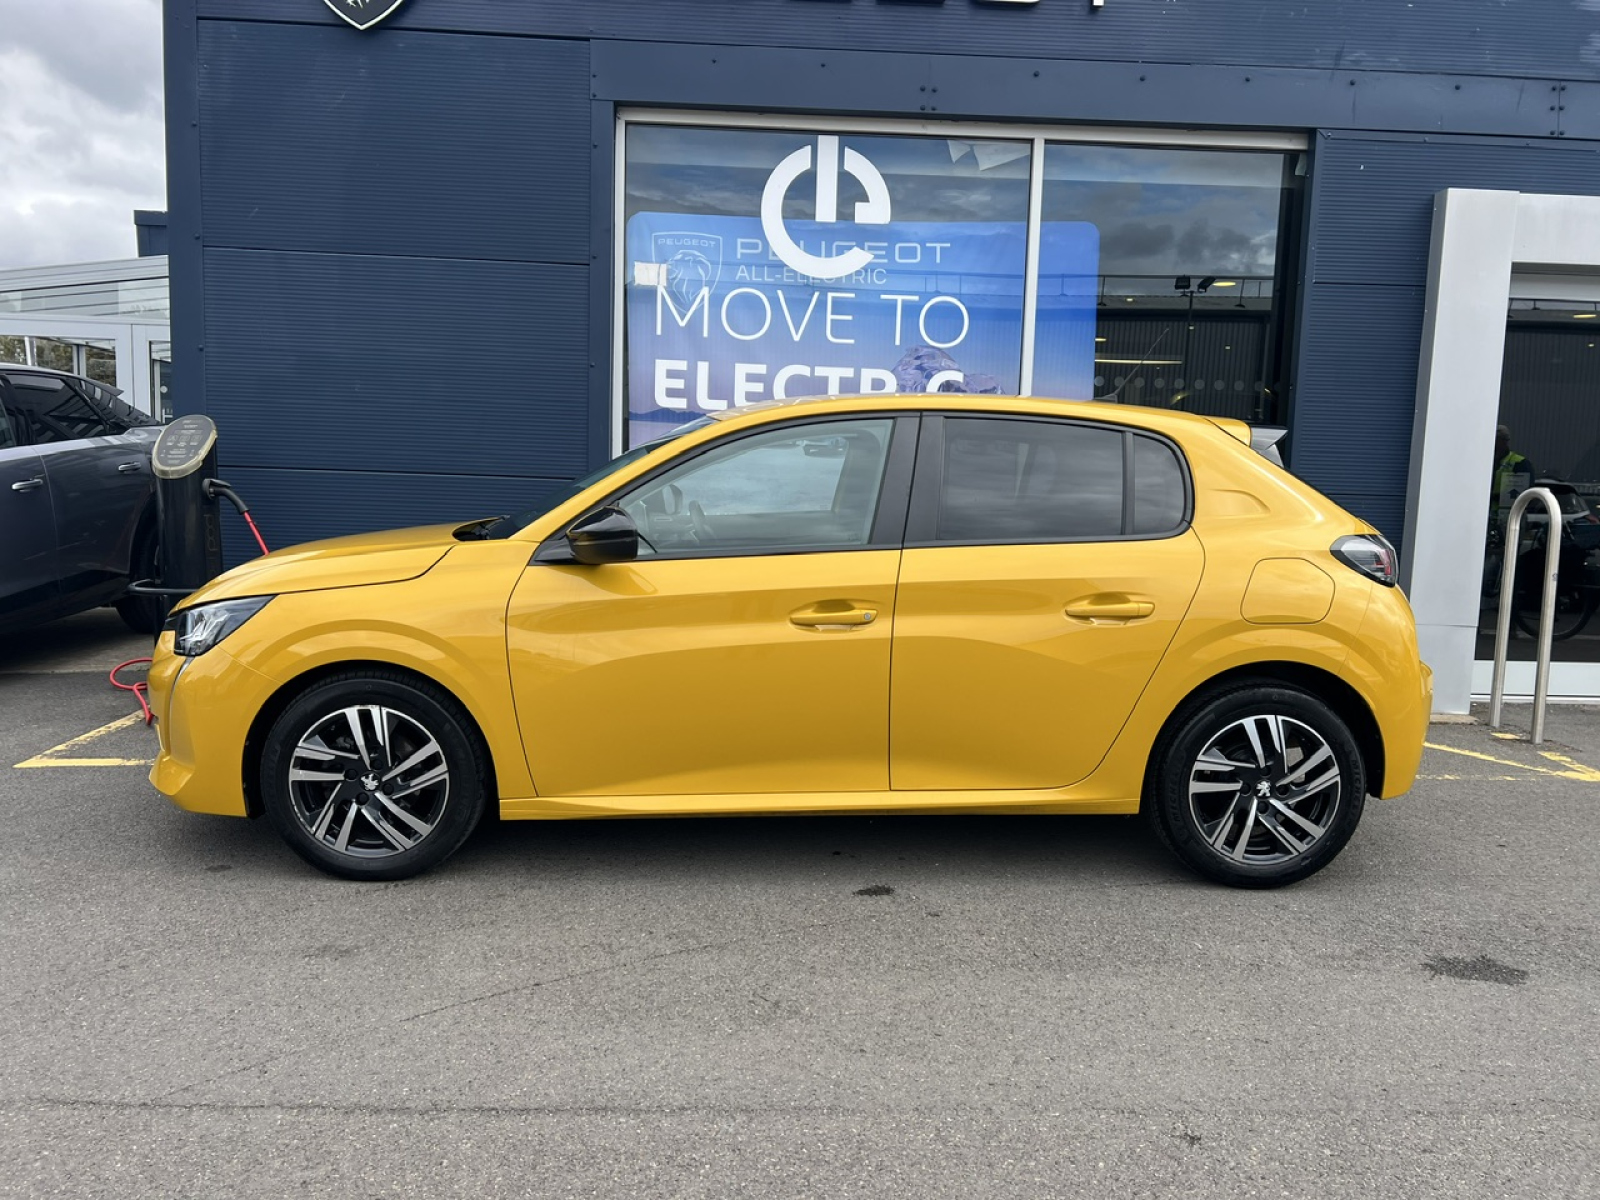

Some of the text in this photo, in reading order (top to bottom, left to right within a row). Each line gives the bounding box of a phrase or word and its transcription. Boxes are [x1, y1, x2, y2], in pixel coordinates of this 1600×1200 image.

[658, 238, 716, 247] PEUGEOT
[655, 284, 970, 349] MOVE TO
